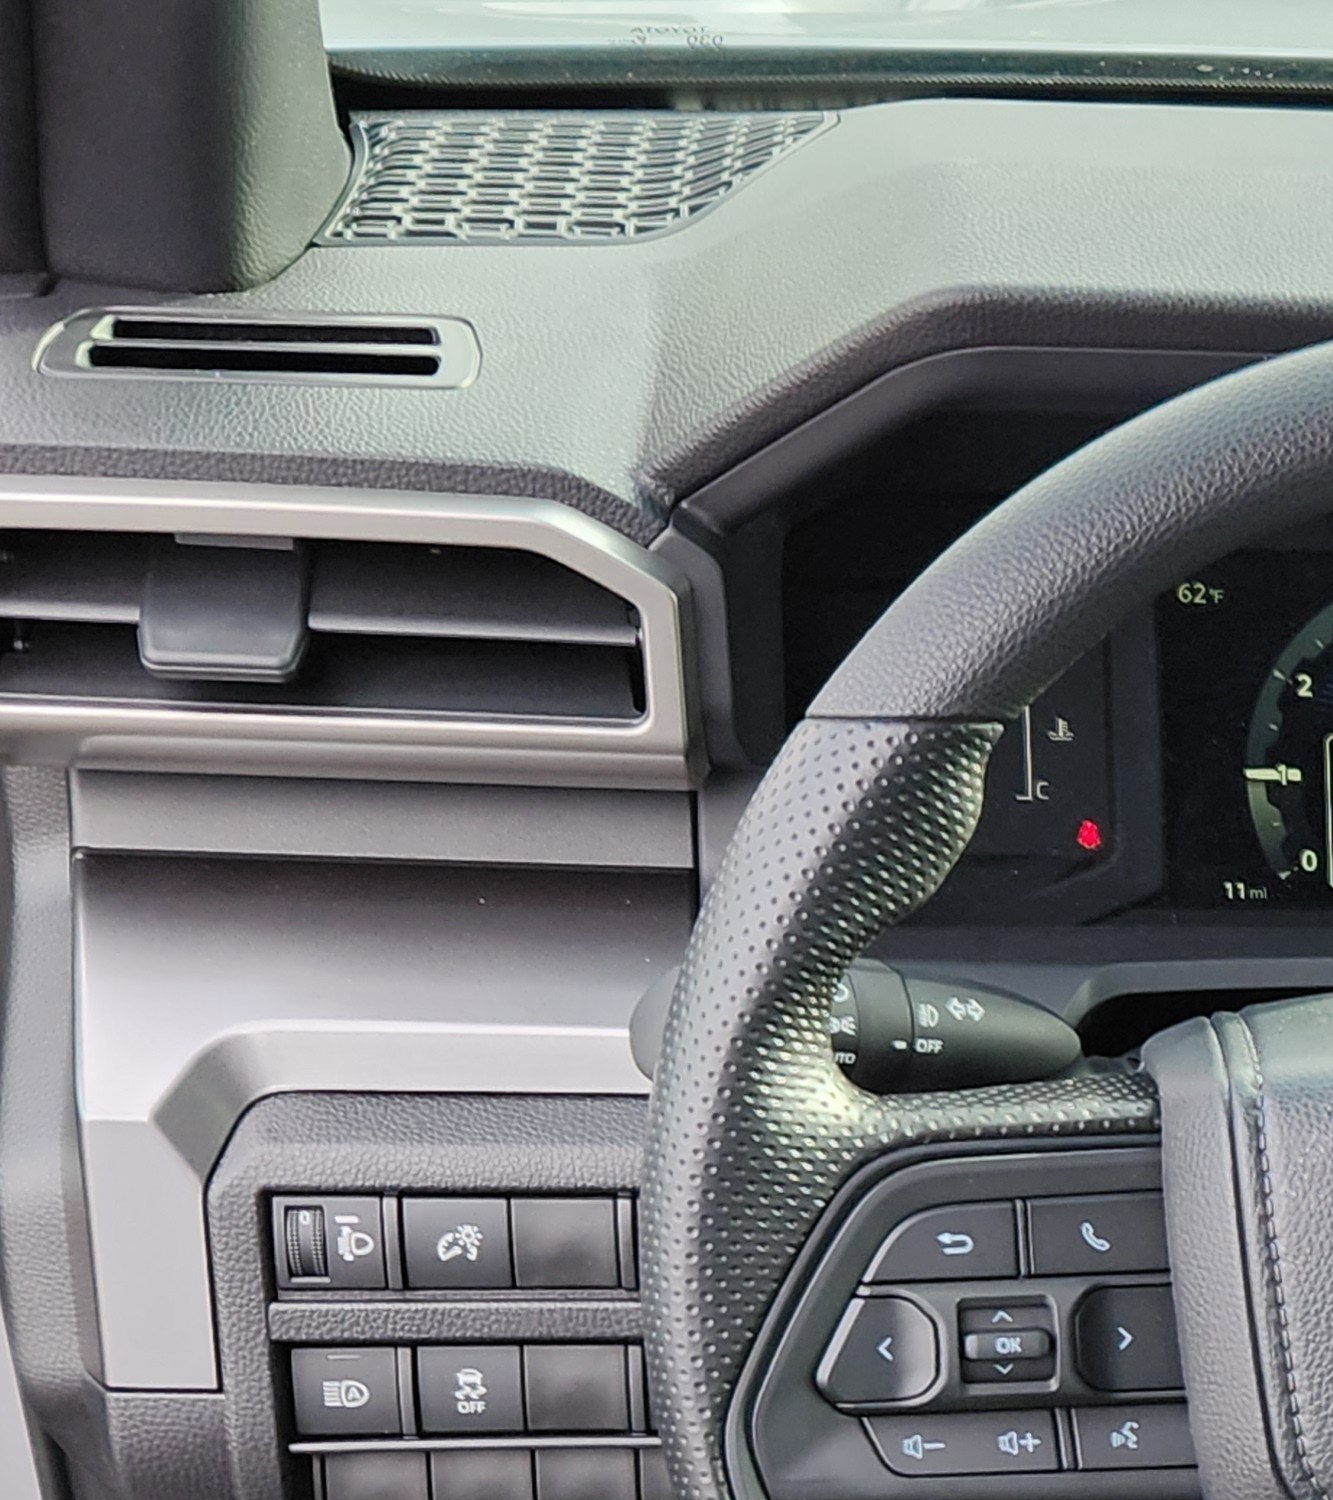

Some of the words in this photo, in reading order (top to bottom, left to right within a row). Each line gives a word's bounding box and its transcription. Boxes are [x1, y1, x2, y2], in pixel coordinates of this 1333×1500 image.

[1296, 675, 1314, 698] 2
[1300, 849, 1319, 873] 0
[1223, 882, 1246, 901] 11
[914, 1038, 945, 1055] OFF
[994, 1336, 1023, 1354] OK
[456, 1400, 487, 1415] OFF
